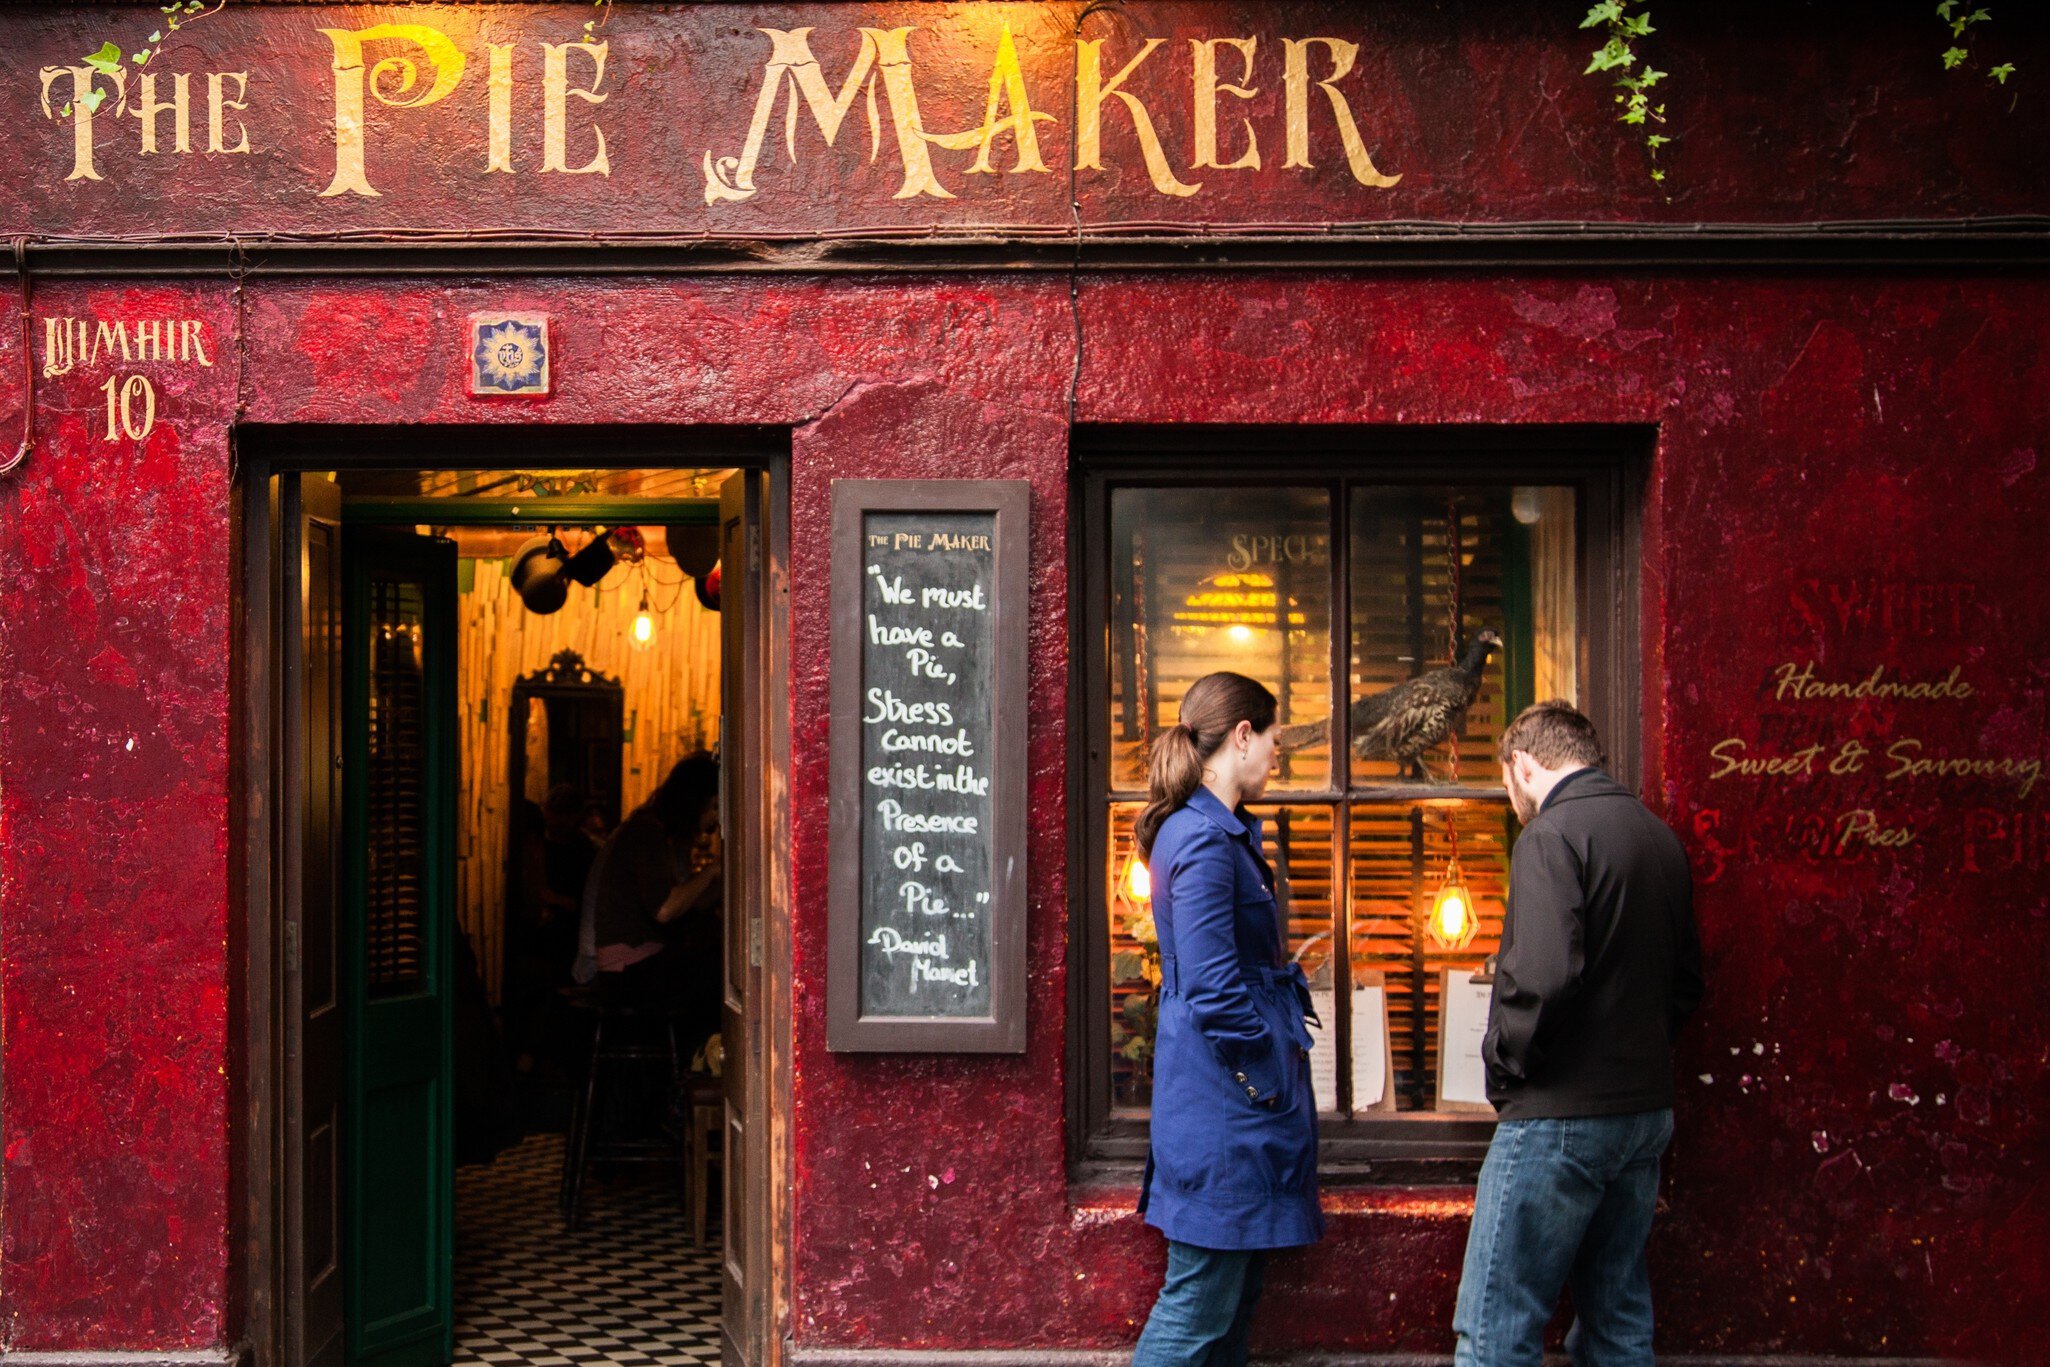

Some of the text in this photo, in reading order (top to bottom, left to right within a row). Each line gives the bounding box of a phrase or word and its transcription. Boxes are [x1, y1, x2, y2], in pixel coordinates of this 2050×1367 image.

[39, 21, 1404, 207] THE PIE MAKER
[99, 374, 156, 442] 10
[868, 532, 992, 552] THE PIE MAKER
[1227, 532, 1320, 573] SPECI
[921, 584, 986, 611] must
[868, 614, 966, 648] have a
[905, 647, 957, 686] Pie,
[1774, 659, 1975, 701] Handmade
[863, 687, 954, 727] Stress
[867, 761, 936, 790] exist
[1709, 738, 1826, 780] Sweet
[1828, 739, 1870, 775] &
[1884, 738, 2047, 799] Savoury
[877, 798, 979, 835] Presence
[1836, 808, 1917, 848] Pies
[934, 854, 965, 874] a
[909, 955, 979, 990] Mamet
